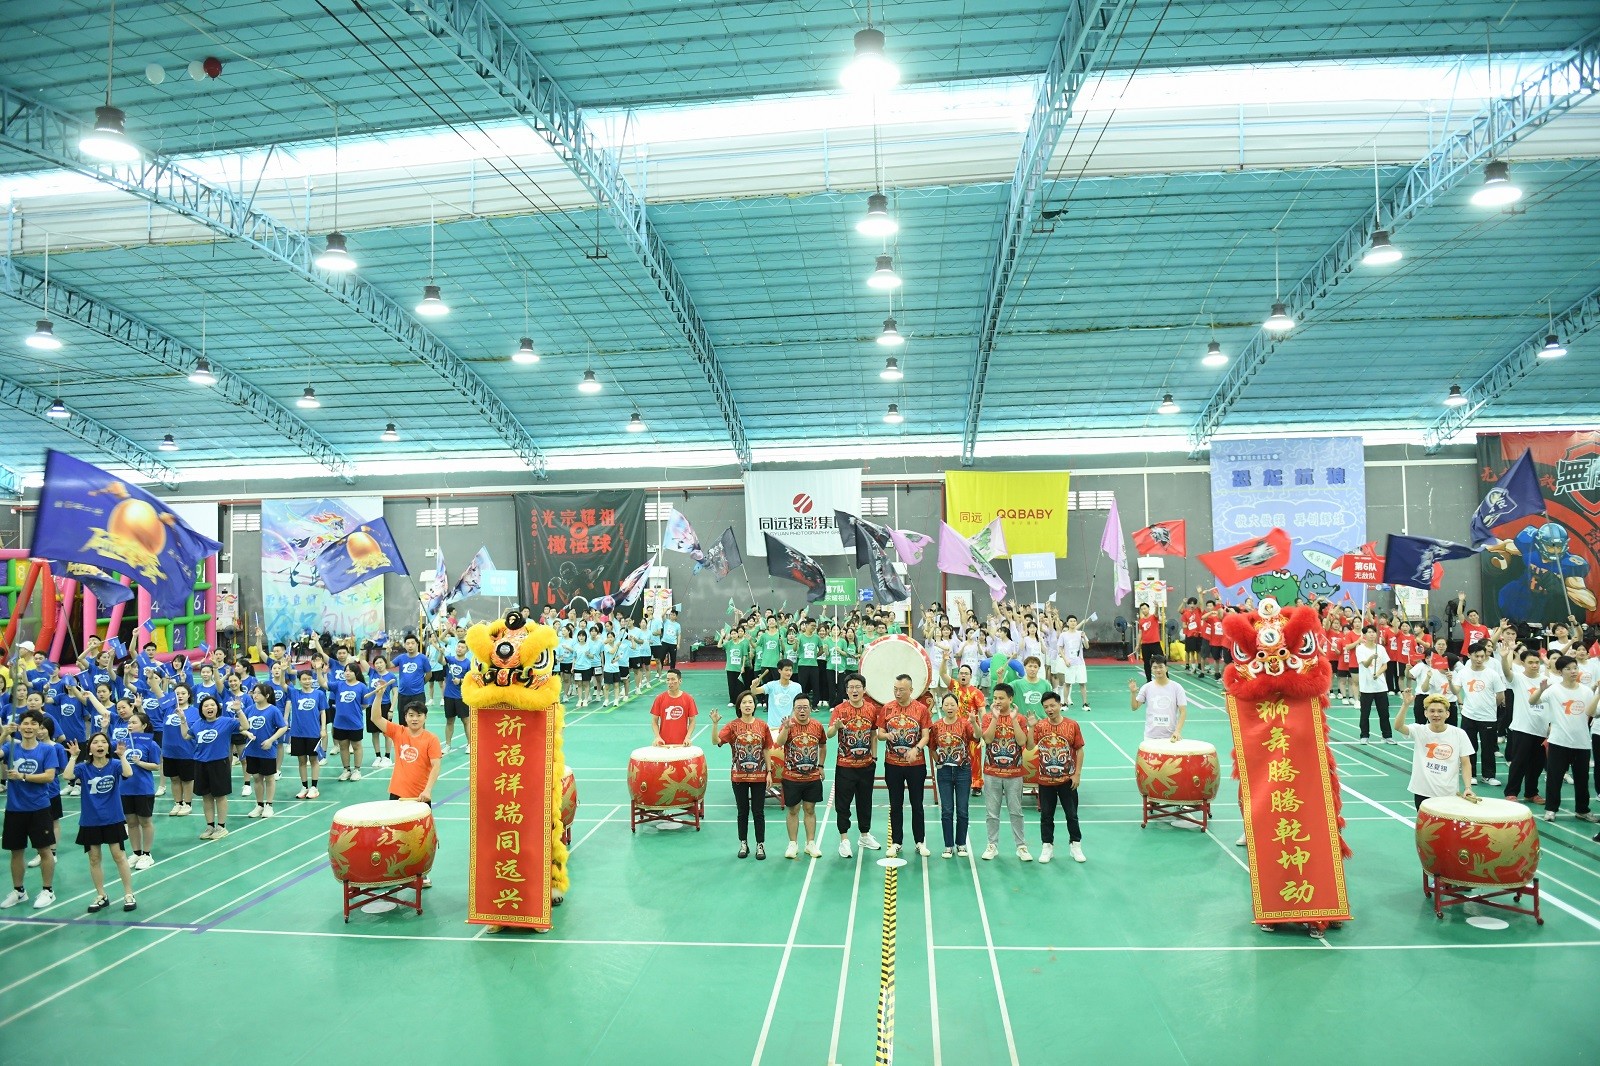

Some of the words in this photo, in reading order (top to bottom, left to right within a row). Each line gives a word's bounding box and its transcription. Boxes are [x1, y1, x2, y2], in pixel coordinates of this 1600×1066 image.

[1232, 467, 1346, 488] 恐龙抗狼
[541, 508, 616, 529] 光宗耀祖
[960, 511, 983, 524] 同远
[996, 508, 1053, 520] QQBABY
[547, 534, 613, 555] 橄榄球
[18, 565, 26, 580] 8
[196, 564, 203, 579] 9
[1354, 562, 1377, 572] 第6队
[1354, 572, 1376, 580] 无敌队
[193, 594, 202, 610] 6
[173, 628, 181, 644] 2
[193, 625, 200, 641] 3
[1256, 700, 1315, 905] 狮舞腾腾乾坤动
[492, 714, 527, 910] 祈福祥瑞同远兴
